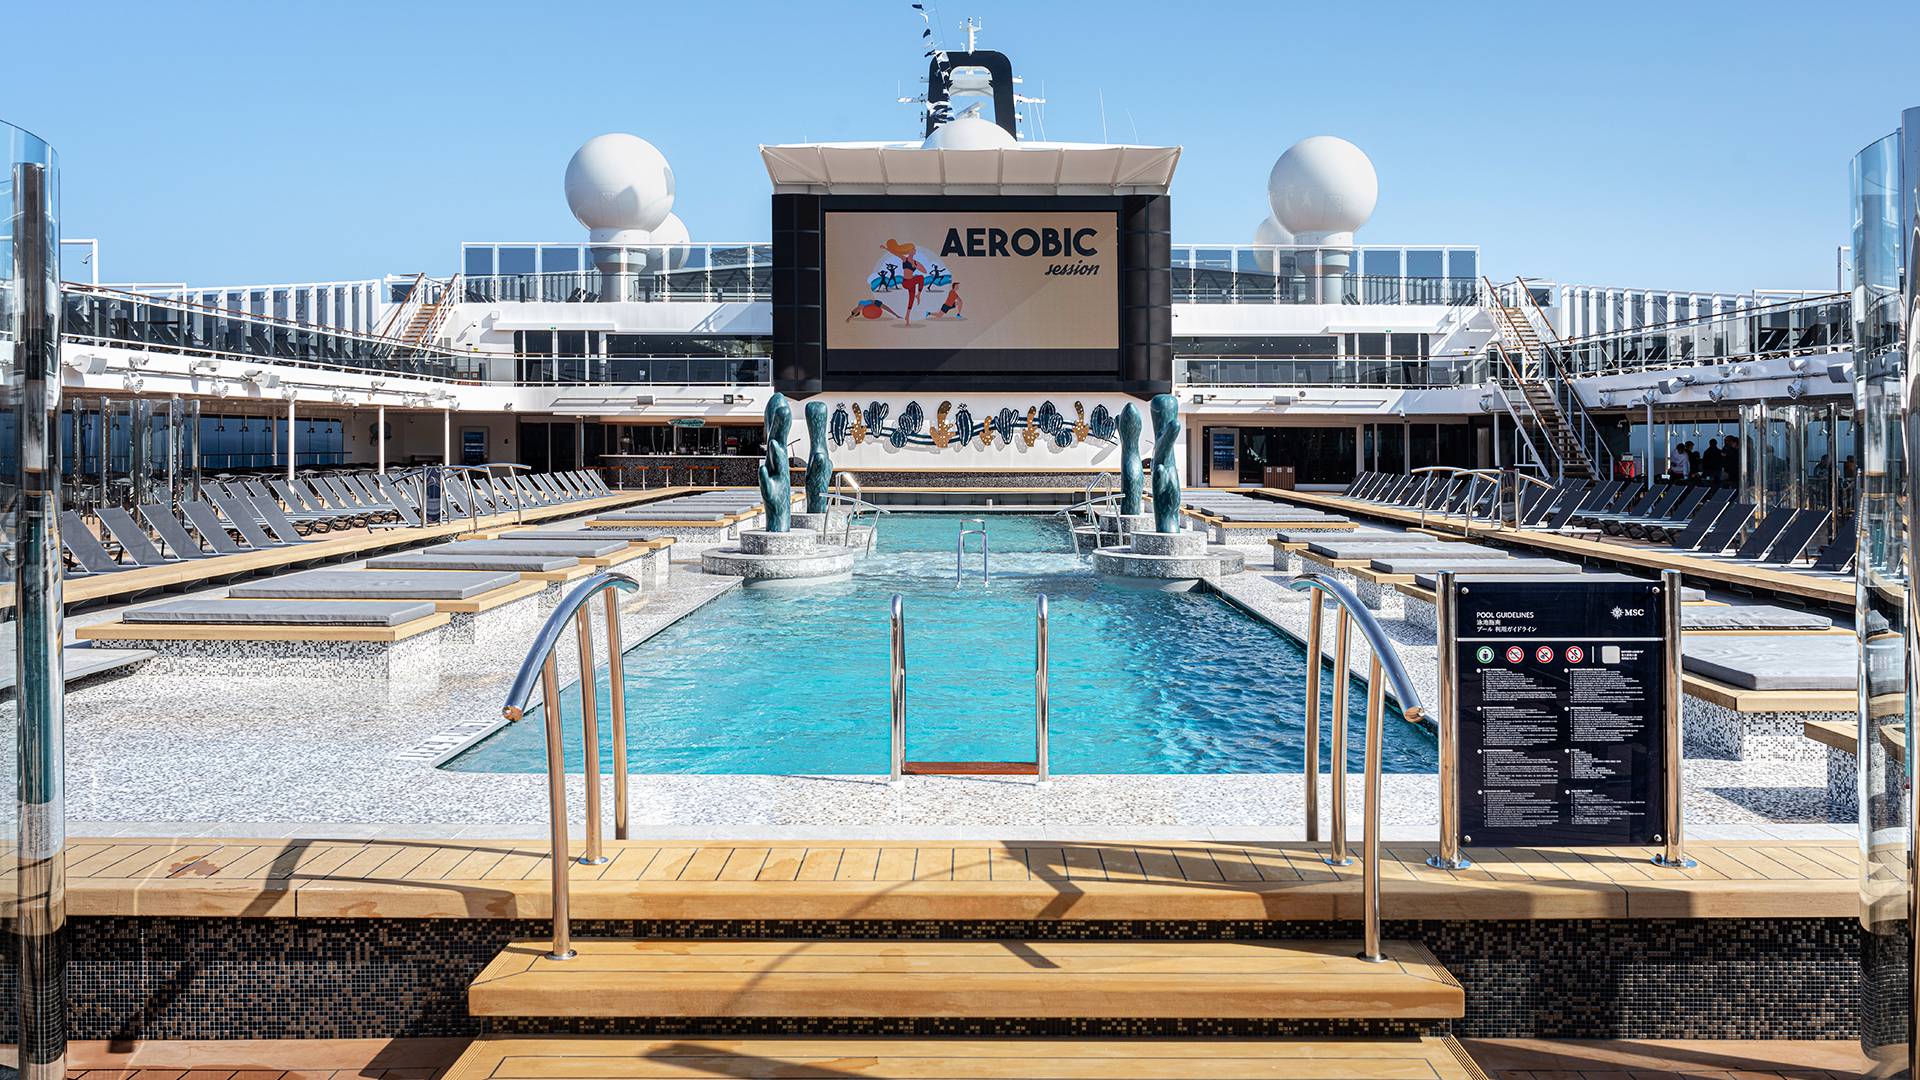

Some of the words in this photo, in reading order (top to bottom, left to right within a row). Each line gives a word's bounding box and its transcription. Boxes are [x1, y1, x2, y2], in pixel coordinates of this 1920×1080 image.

[940, 227, 1098, 257] AEROBIC
[1045, 260, 1100, 276] session
[1476, 611, 1494, 619] POOL
[1495, 611, 1535, 619] GUIDELINES
[1624, 608, 1645, 617] MSC
